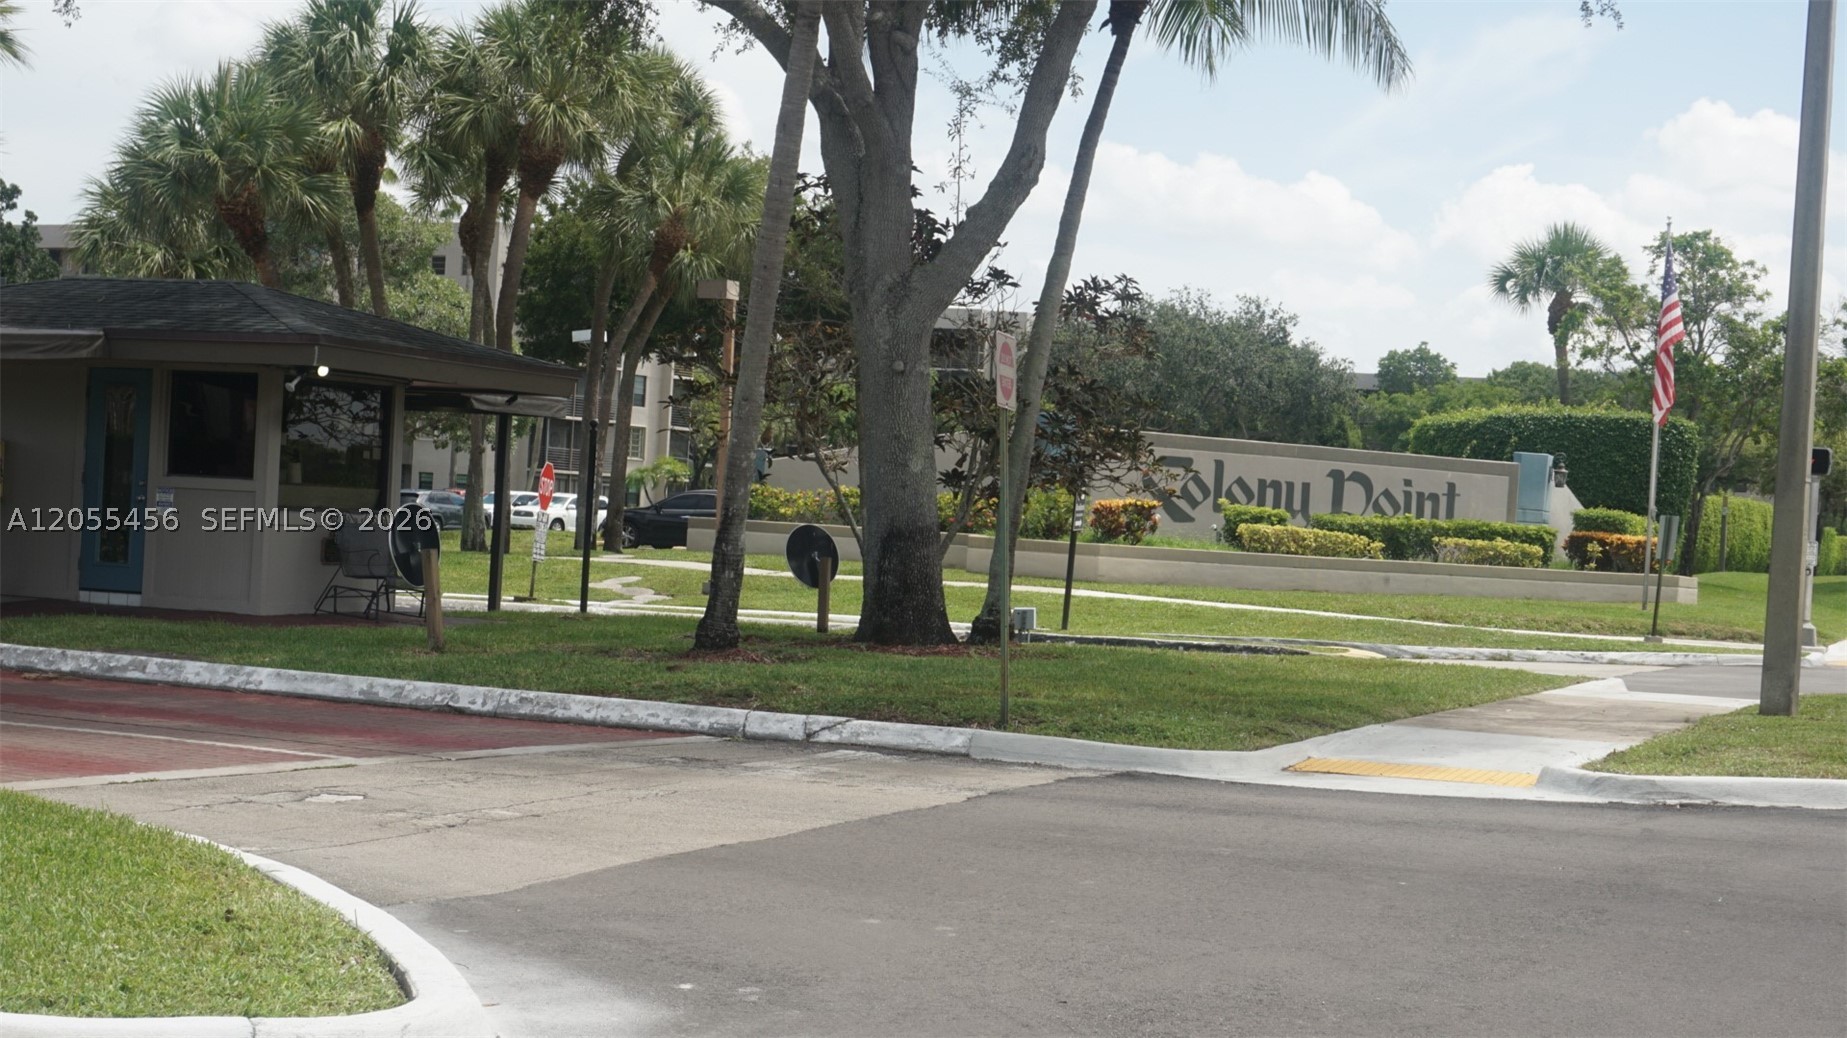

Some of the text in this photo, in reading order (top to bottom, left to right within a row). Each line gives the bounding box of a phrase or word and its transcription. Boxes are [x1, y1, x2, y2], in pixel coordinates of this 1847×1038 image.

[539, 477, 554, 497] STOP
[1141, 455, 1312, 528] Colony
[1326, 468, 1461, 520] Point
